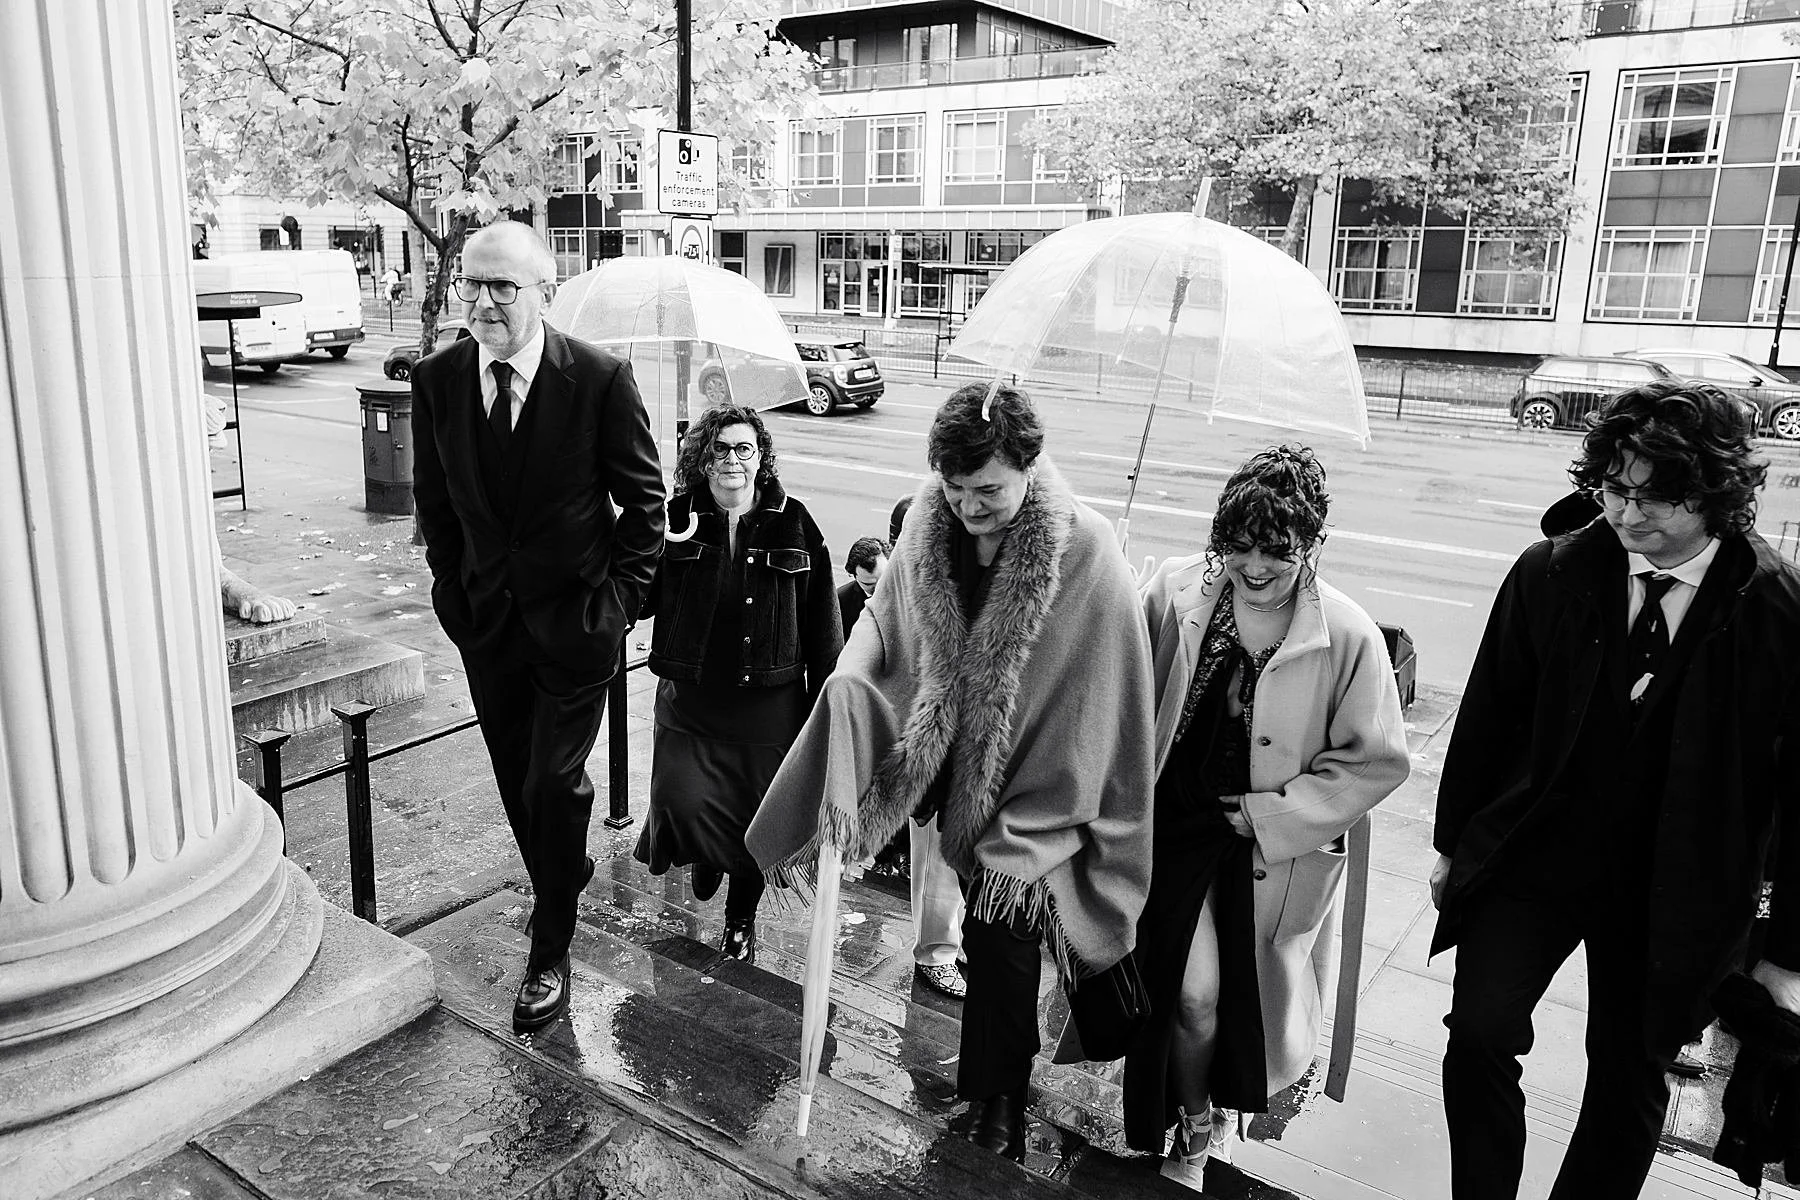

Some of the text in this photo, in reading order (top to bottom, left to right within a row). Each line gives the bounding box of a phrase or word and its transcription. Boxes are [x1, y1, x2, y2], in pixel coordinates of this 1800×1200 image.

[675, 170, 703, 183] Traffic
[662, 184, 715, 196] enforcement
[671, 199, 706, 208] cameras
